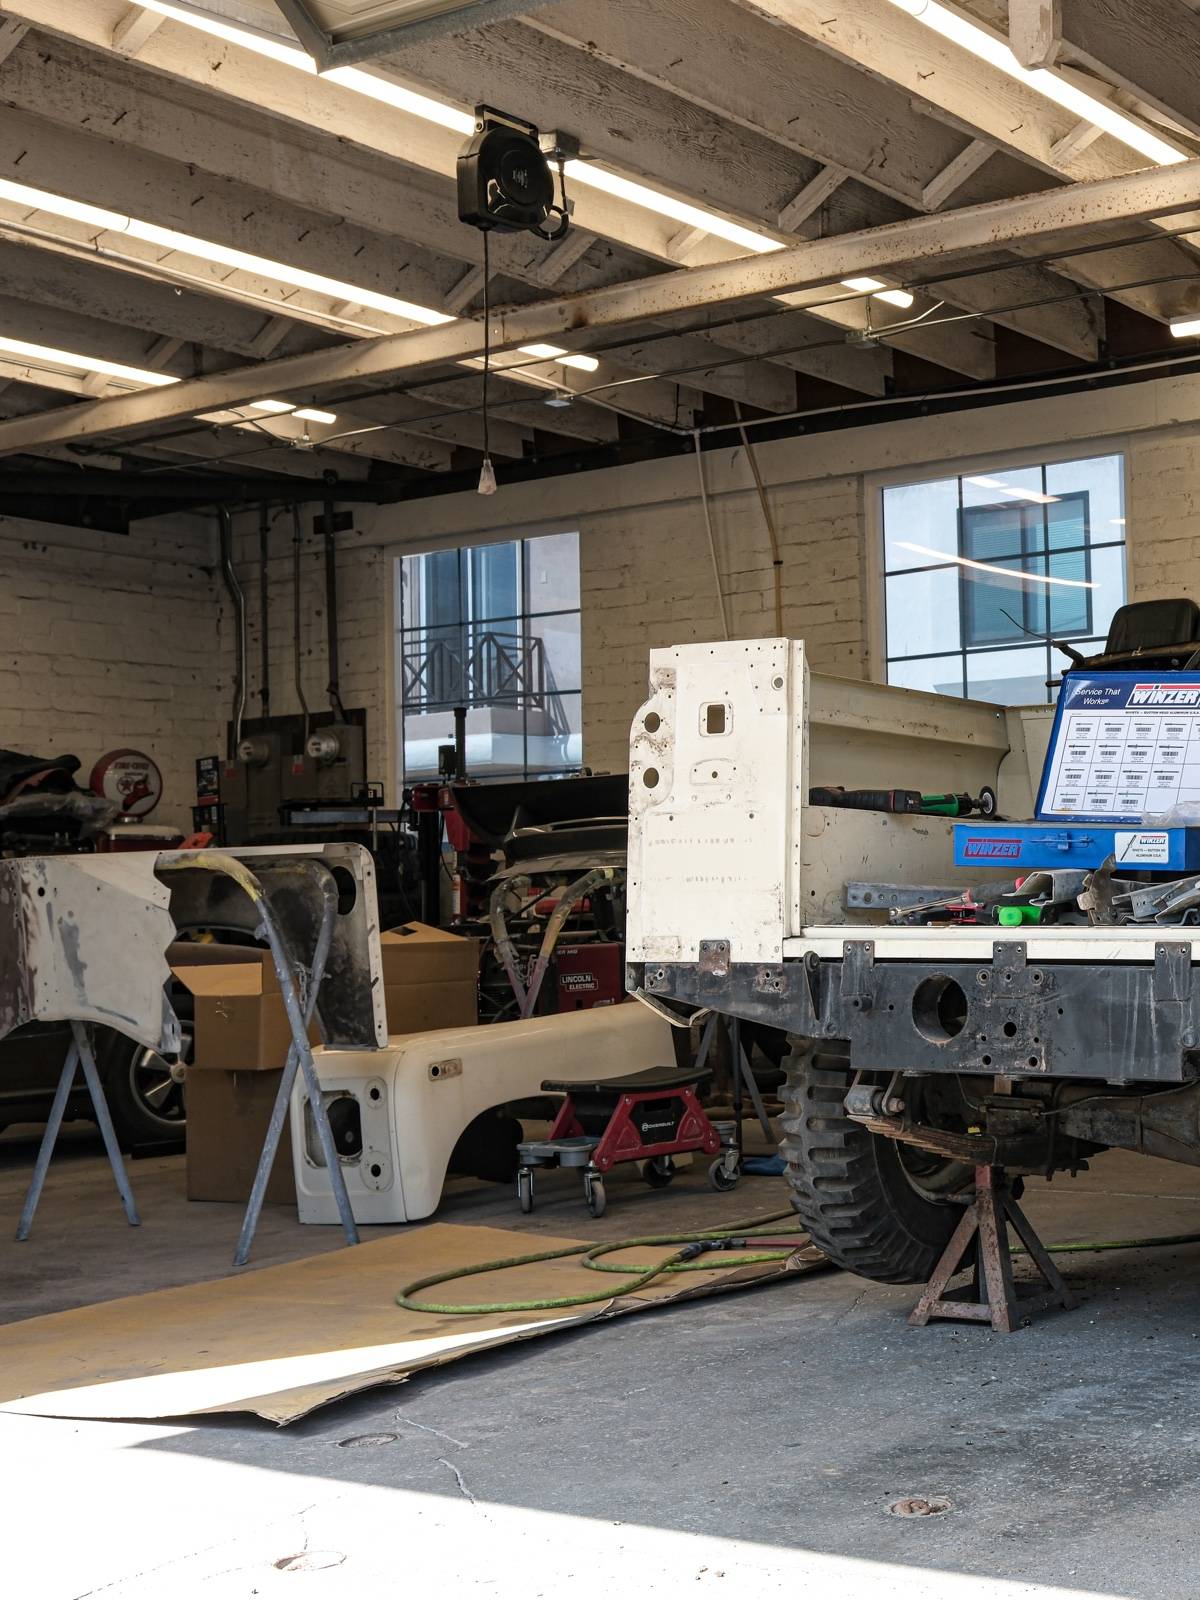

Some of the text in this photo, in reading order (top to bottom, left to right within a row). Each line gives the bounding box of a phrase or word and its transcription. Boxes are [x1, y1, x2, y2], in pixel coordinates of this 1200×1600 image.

[1075, 687, 1121, 696] Service That
[561, 974, 592, 984] LINCOLN
